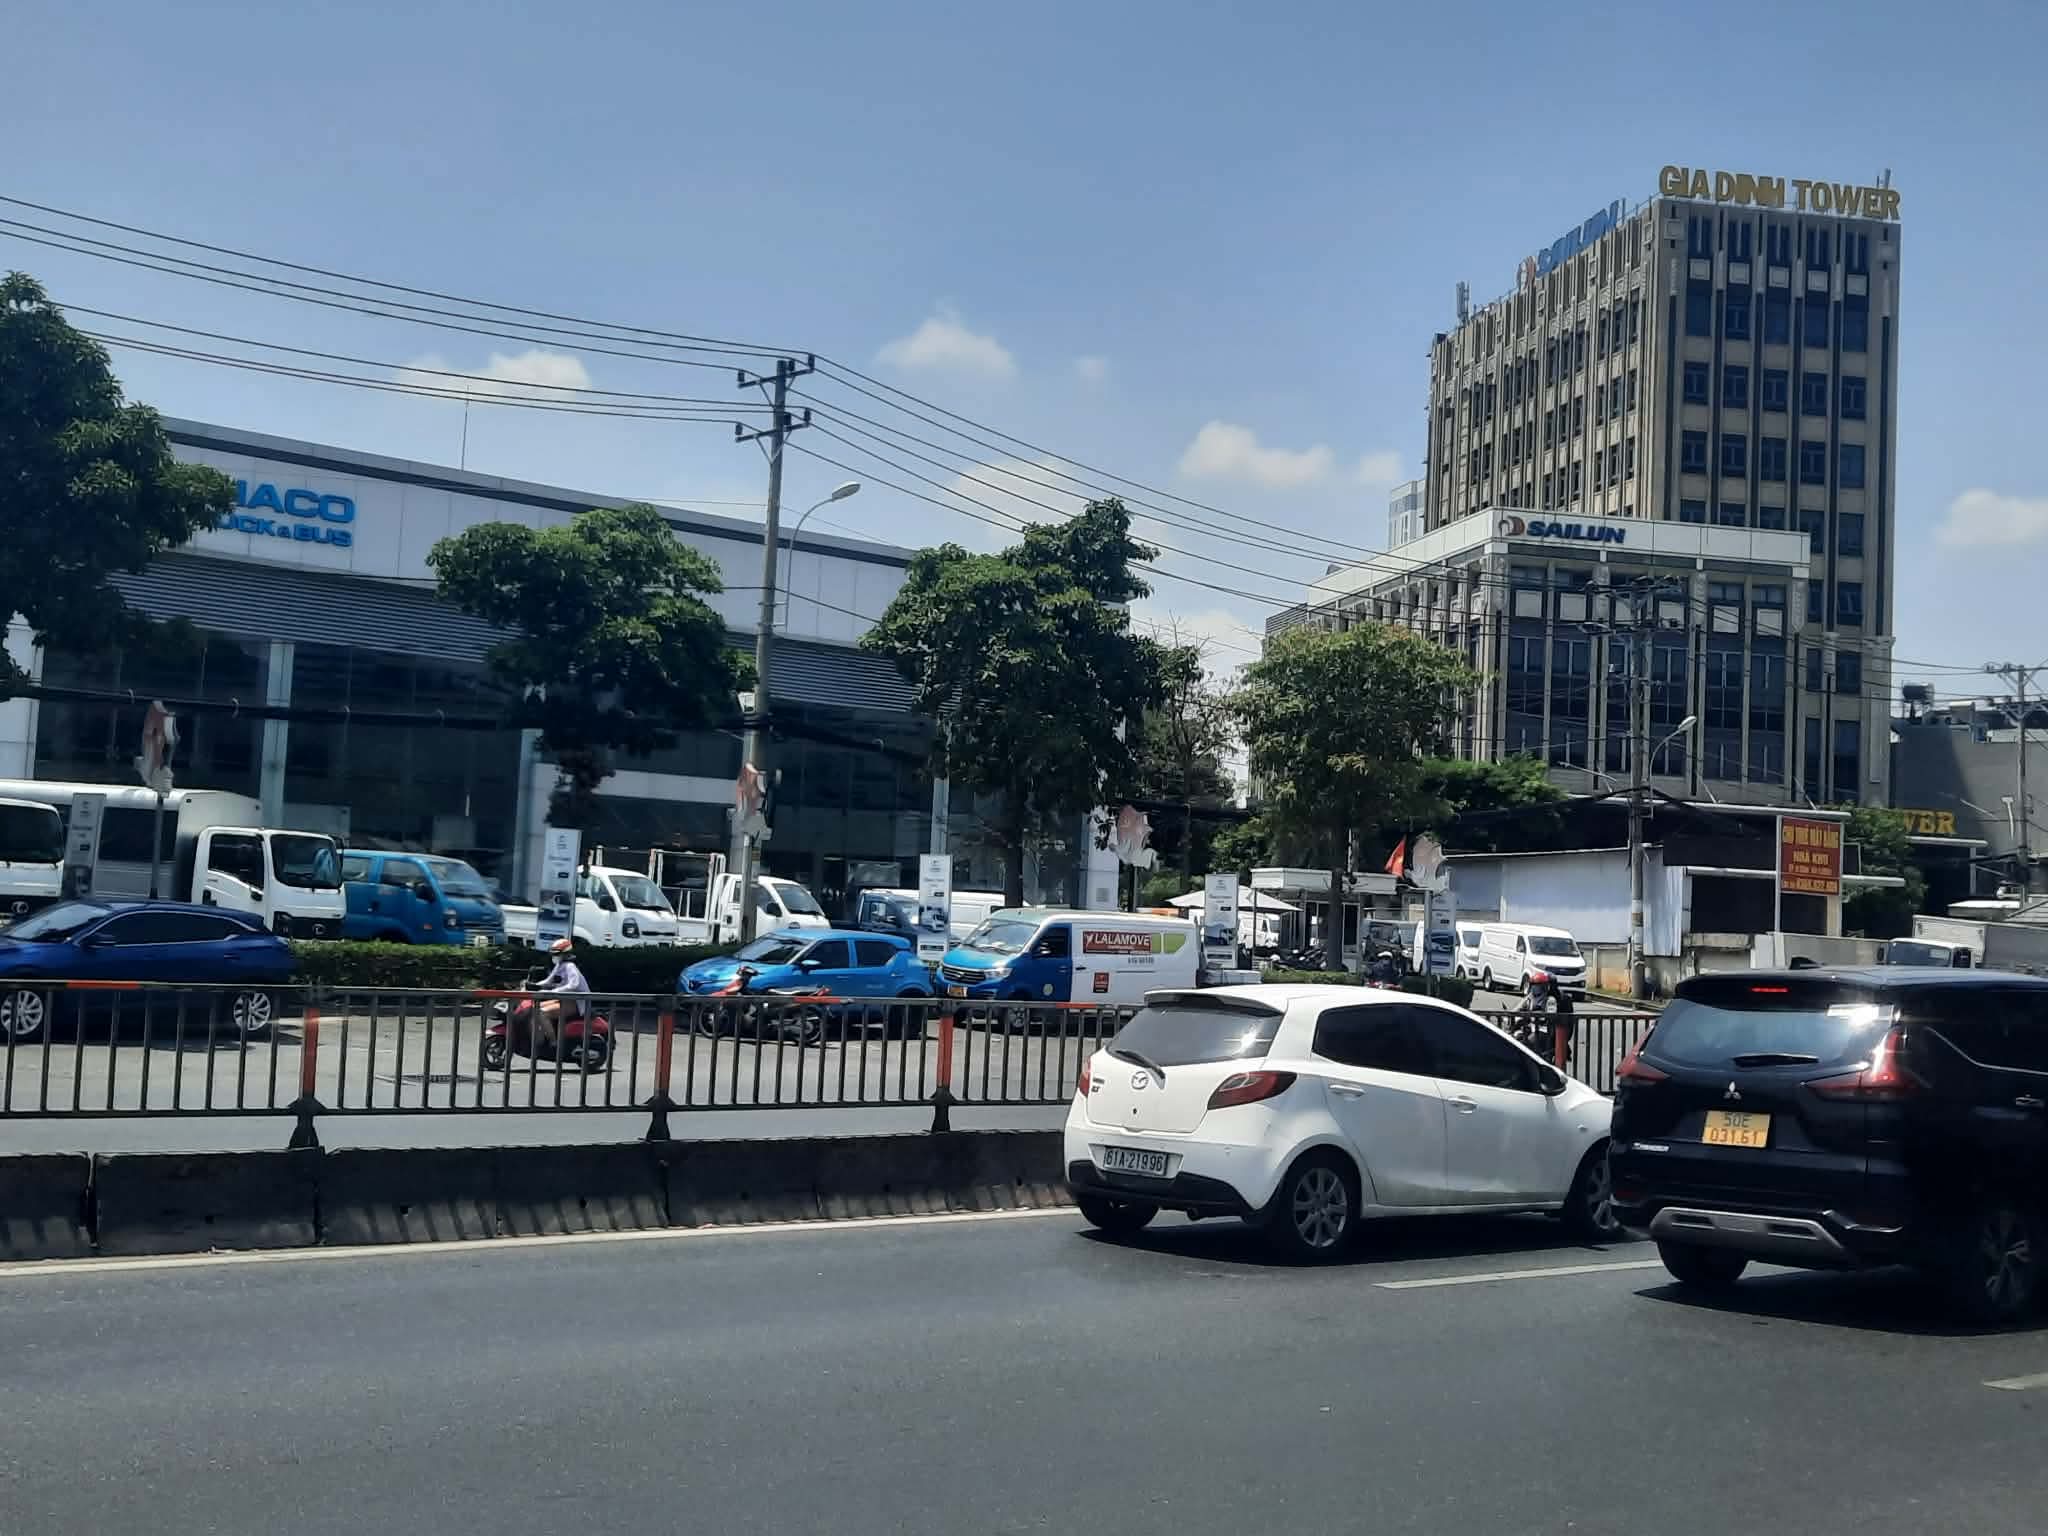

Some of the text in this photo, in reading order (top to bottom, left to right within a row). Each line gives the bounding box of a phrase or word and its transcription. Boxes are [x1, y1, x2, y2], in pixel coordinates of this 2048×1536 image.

[1659, 165, 1711, 199] GIA
[1791, 179, 1900, 220] TOWER
[1527, 521, 1626, 544] SAILUN
[1094, 933, 1150, 946] LALAMOVE
